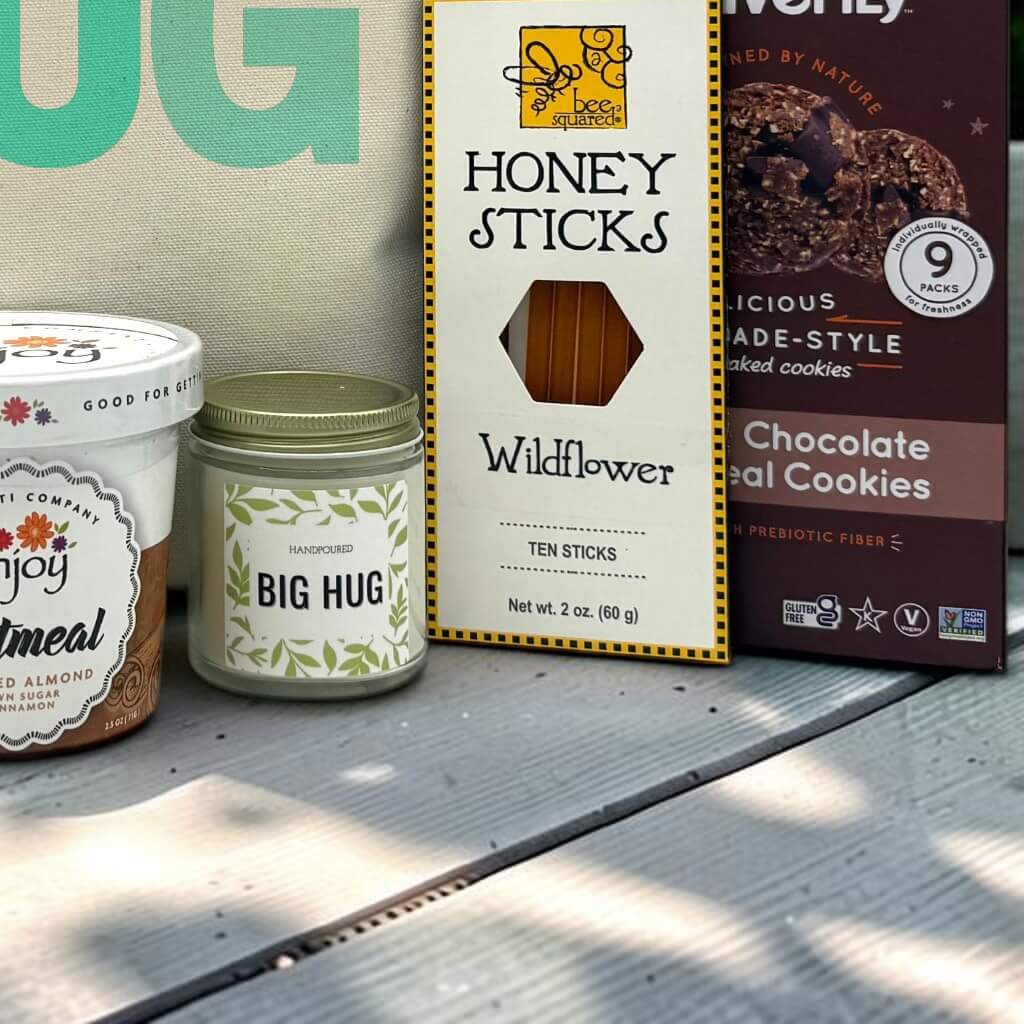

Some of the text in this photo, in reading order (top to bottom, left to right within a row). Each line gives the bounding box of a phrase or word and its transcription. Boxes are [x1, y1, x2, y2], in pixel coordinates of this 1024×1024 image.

[728, 48, 883, 116] NED BY NATURE
[573, 88, 612, 113] bee
[463, 150, 677, 195] HONEY
[469, 207, 670, 254] STICKS
[892, 220, 988, 260] Individually wrapped
[924, 240, 953, 278] 9
[920, 283, 959, 294] PACKS
[905, 295, 972, 314] for freshness
[727, 327, 902, 354] ADE-STYLE
[728, 355, 853, 378] aked cookies
[83, 394, 134, 412] GOOD
[144, 386, 170, 402] FOR
[743, 420, 931, 461] Chocolate
[478, 432, 674, 486] Wildflower
[729, 460, 931, 500] eal Cookies
[26, 492, 101, 526] COMPANY
[749, 525, 833, 543] PREBIOTIC
[840, 532, 885, 547] FIBER
[288, 544, 354, 555] HANDPOURED
[528, 541, 617, 562] TEN STICKS
[257, 570, 384, 610] BIG HUG
[508, 598, 639, 624] Net wt. 2 oz. (60 g)
[785, 602, 816, 615] GLUTEN
[785, 612, 805, 624] FREE
[903, 608, 920, 626] V
[963, 616, 984, 625] GMO
[964, 610, 983, 618] NON
[24, 668, 94, 688] ALMOND
[20, 689, 60, 700] SUGAR
